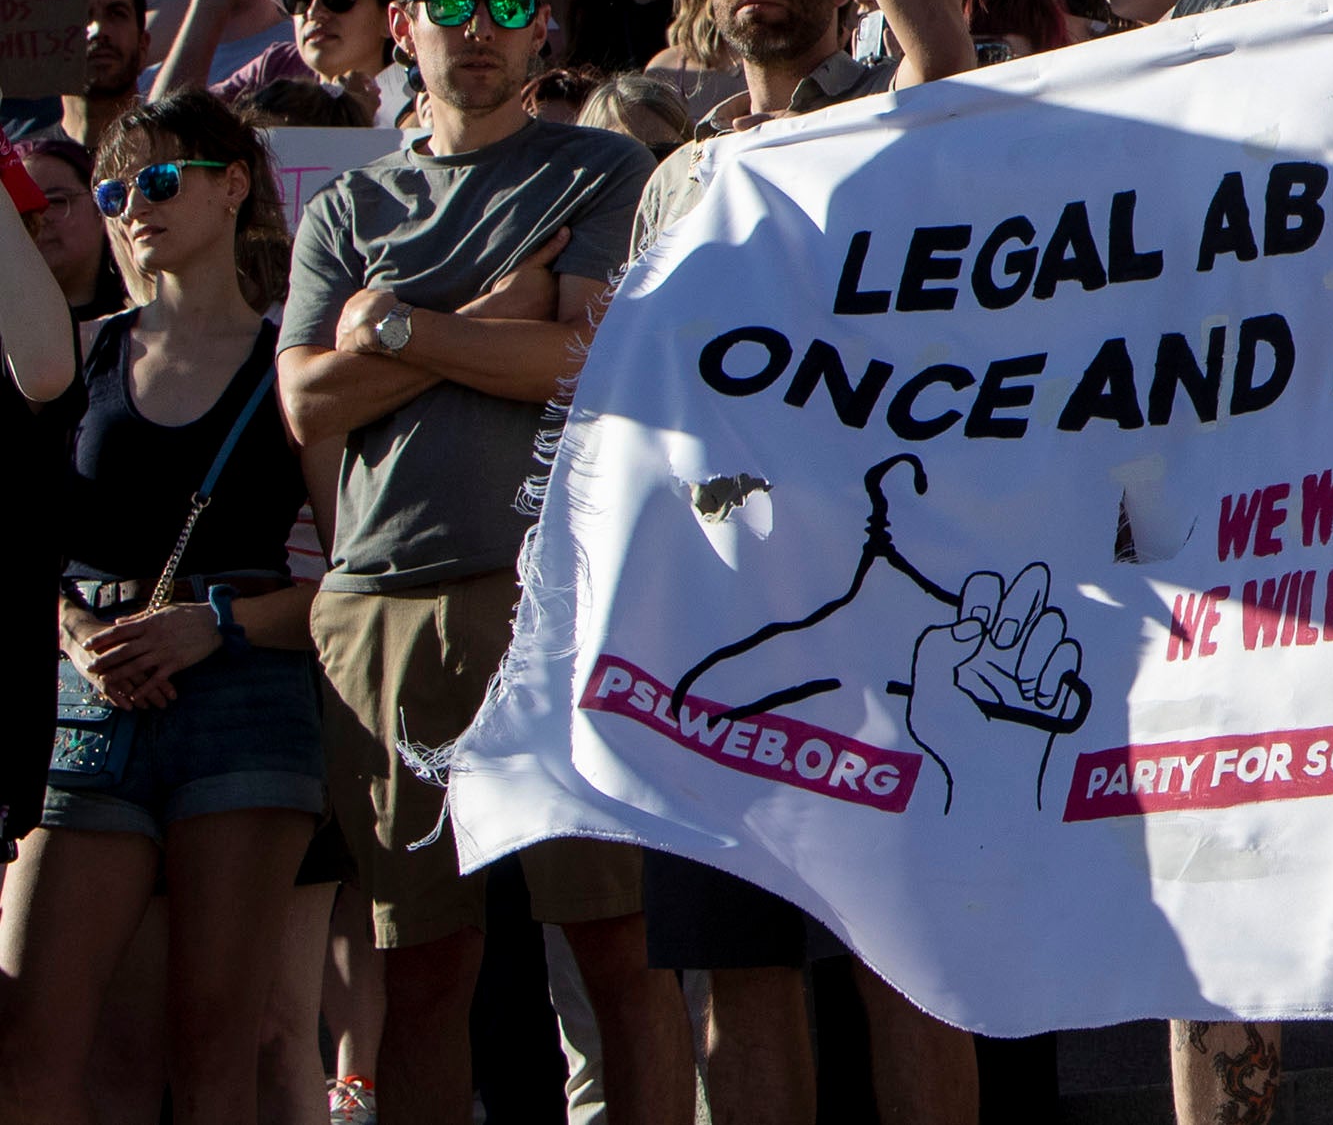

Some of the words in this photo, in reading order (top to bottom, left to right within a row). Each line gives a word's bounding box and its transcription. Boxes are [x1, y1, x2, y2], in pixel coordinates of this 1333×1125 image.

[832, 189, 1163, 316] LEGAL
[698, 325, 1048, 441] ONCE
[1057, 312, 1296, 431] AND
[1217, 482, 1291, 562] WE
[1166, 586, 1231, 663] WE
[595, 665, 901, 796] PSLWEB.ORG
[1086, 752, 1203, 800] PARTY
[1210, 742, 1293, 787] FOR
